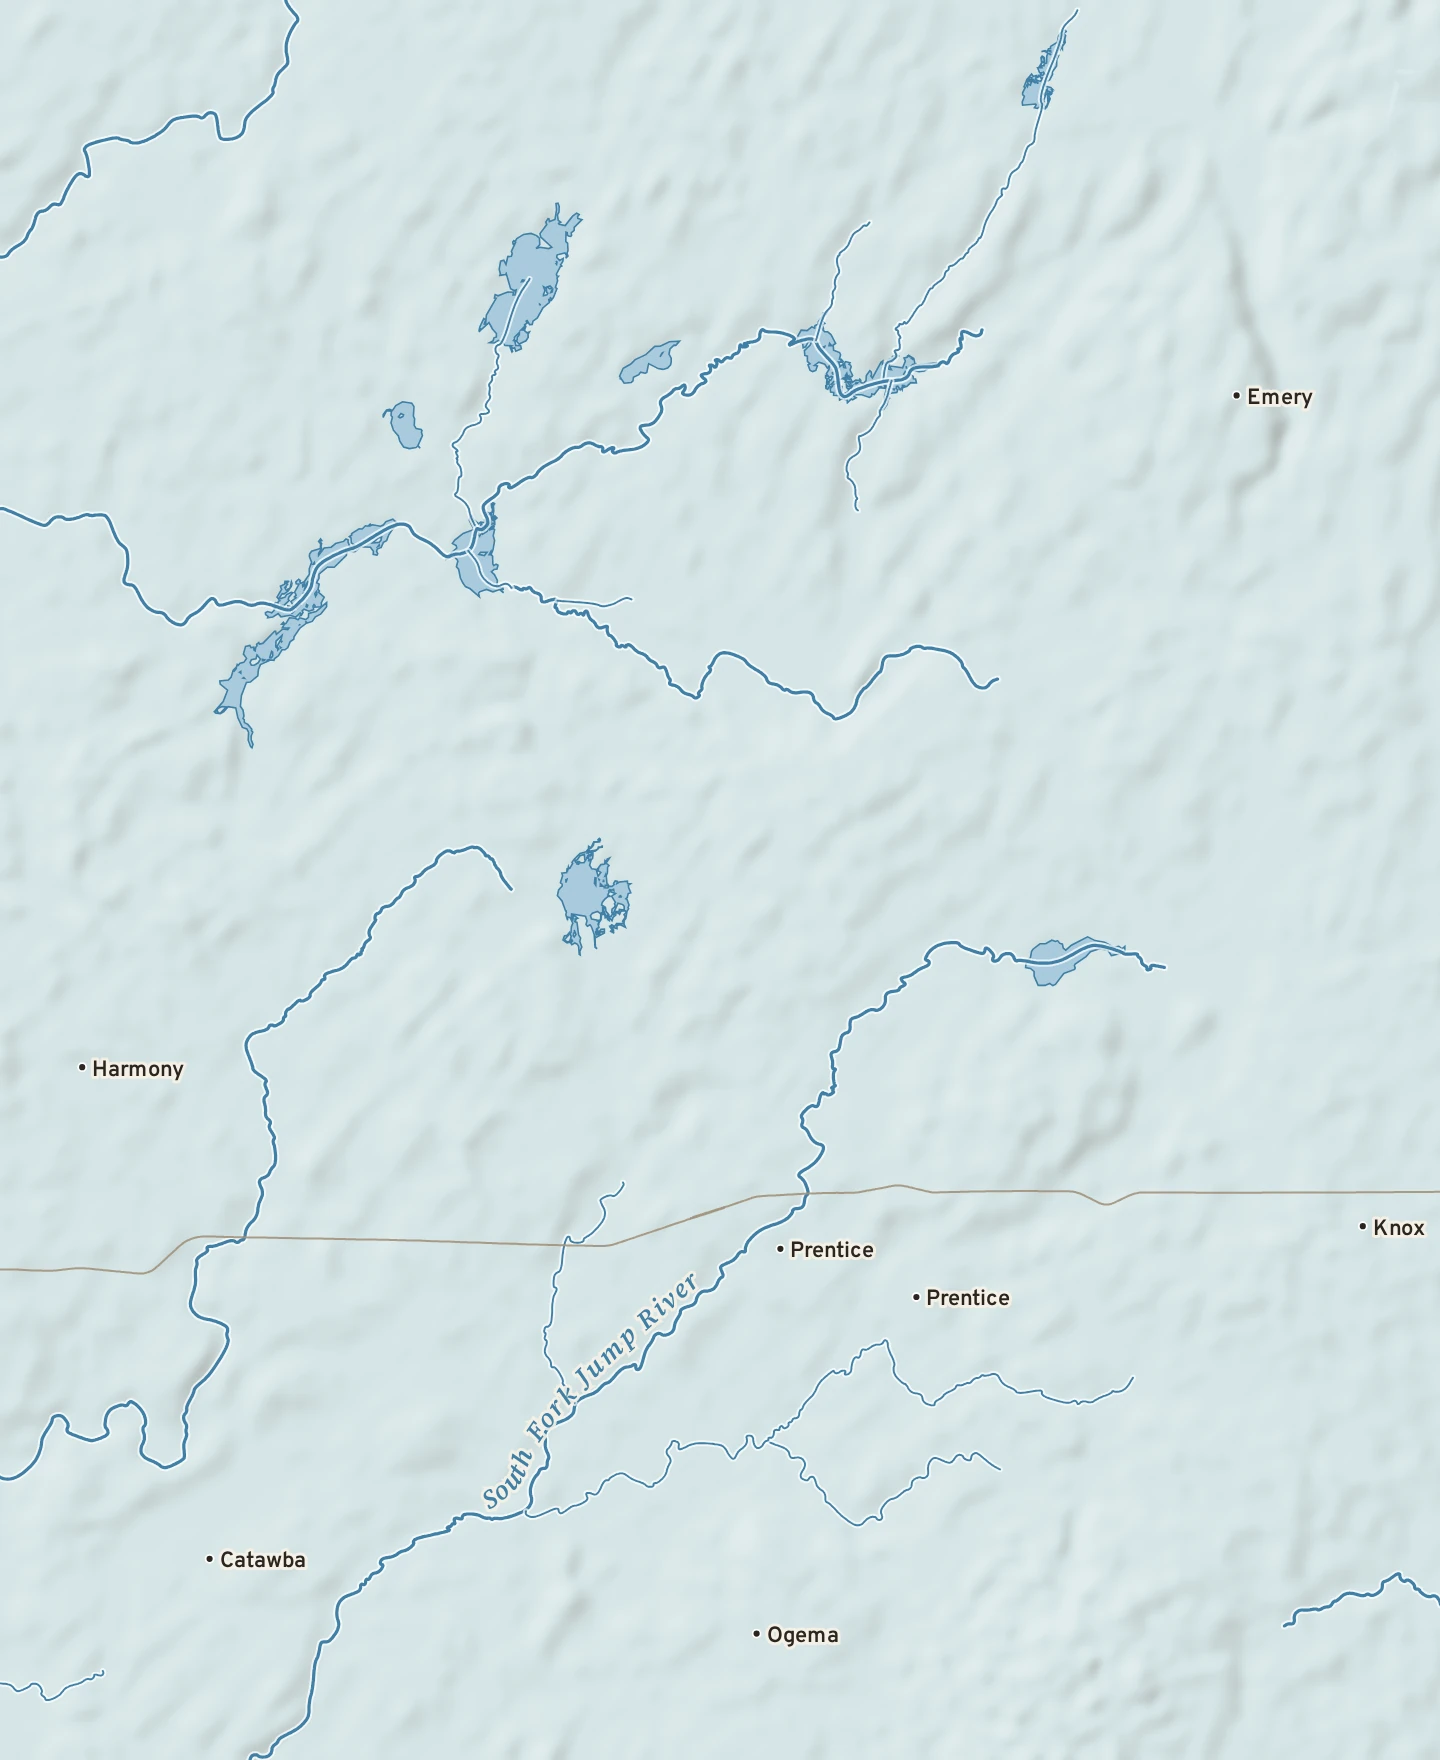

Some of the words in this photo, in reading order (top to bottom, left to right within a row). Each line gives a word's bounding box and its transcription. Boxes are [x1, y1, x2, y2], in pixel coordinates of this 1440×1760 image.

[1248, 388, 1313, 409] Emery
[93, 1060, 184, 1081] Harmony
[1374, 1219, 1425, 1236] Knox
[791, 1241, 874, 1258] Prentice
[927, 1289, 1010, 1306] Prentice
[483, 1450, 533, 1510] South
[526, 1387, 578, 1443] Fork
[574, 1327, 636, 1392] Jump
[636, 1273, 696, 1331] River
[220, 1550, 305, 1568] Catawba
[768, 1625, 838, 1647] Ogema
